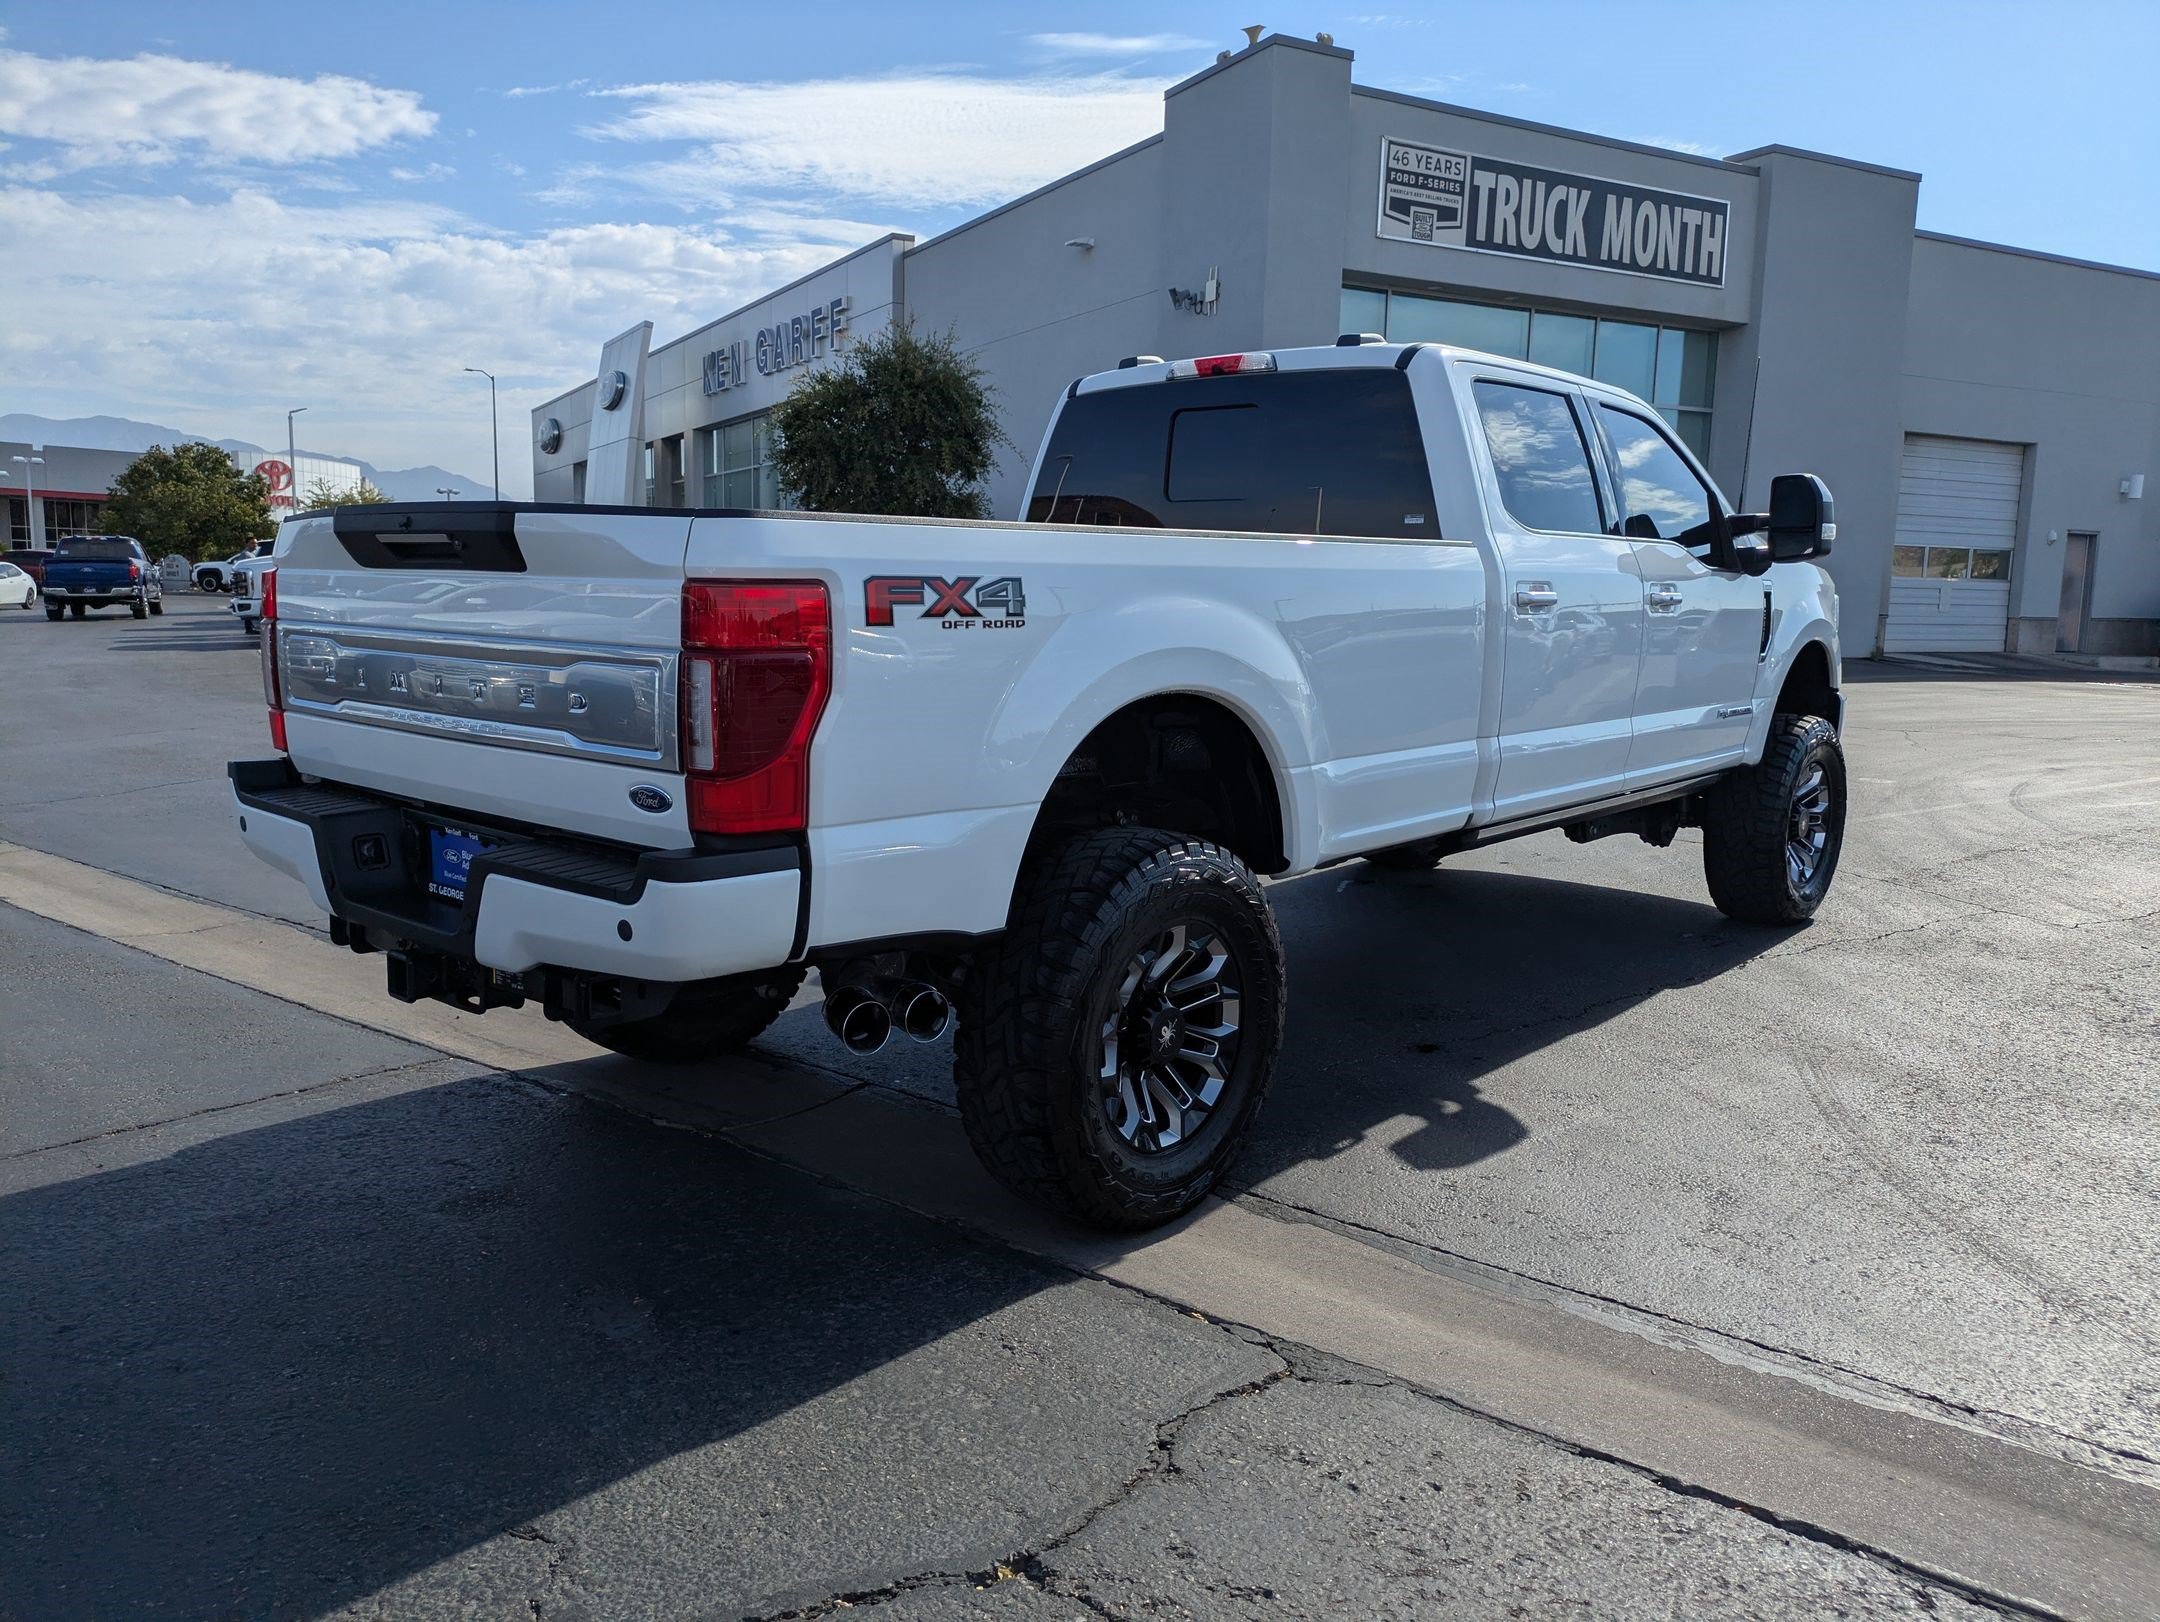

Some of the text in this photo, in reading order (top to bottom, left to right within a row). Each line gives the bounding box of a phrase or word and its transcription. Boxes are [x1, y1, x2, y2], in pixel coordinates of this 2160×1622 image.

[1392, 150, 1462, 176] 46 YEARS
[1390, 171, 1461, 192] FORD F-SERIES
[1473, 169, 1724, 278] TRUCK MONTH
[702, 295, 849, 396] KEN GARFF
[863, 575, 1026, 627] FX4
[941, 620, 1026, 630] OFF ROAD
[323, 664, 589, 714] LIMITED
[635, 789, 660, 808] Ford
[428, 882, 464, 901] ST. GEORGE
